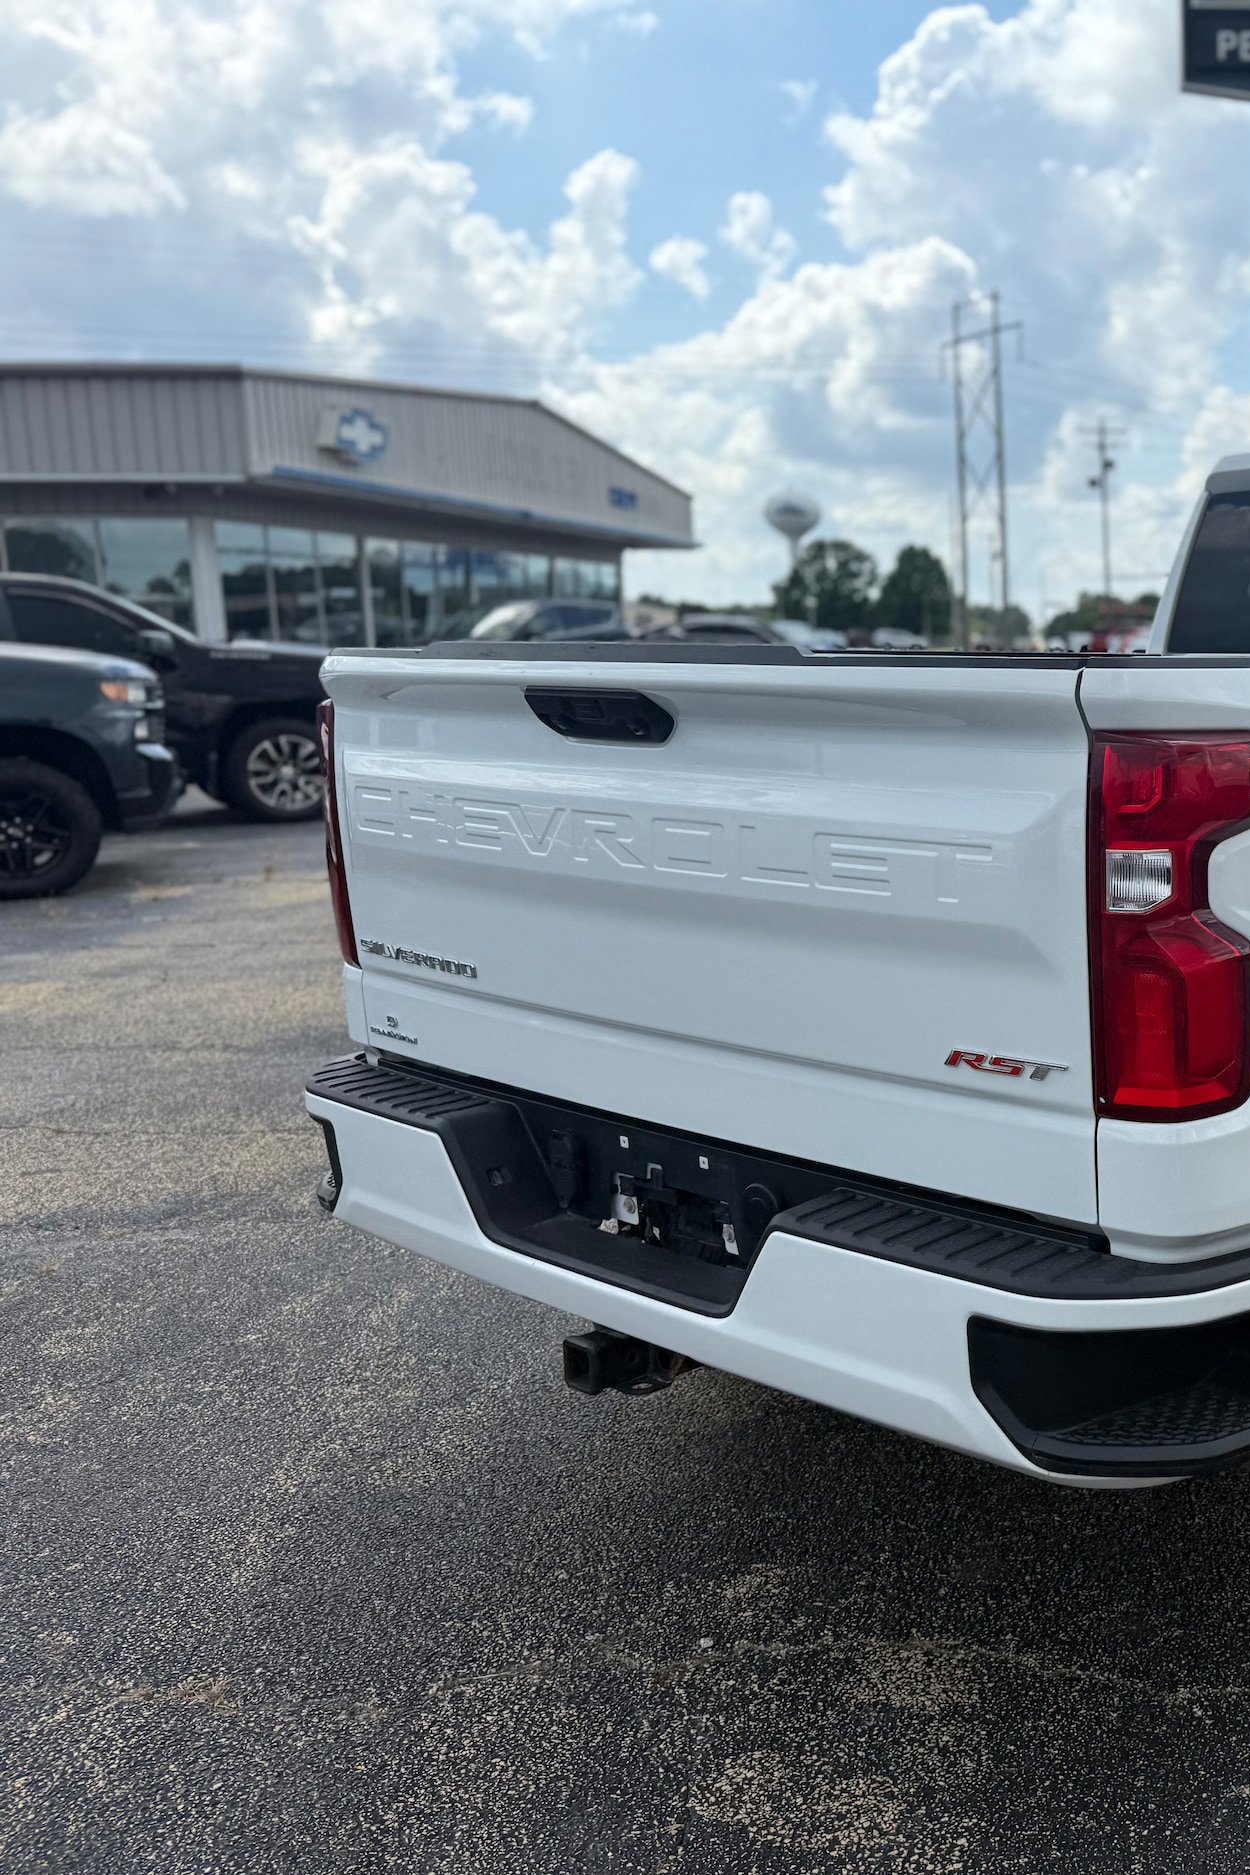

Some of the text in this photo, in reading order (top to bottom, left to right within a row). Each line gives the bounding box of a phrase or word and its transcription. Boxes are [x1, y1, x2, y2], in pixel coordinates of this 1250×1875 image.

[352, 783, 998, 905] CHEVROLET
[360, 938, 478, 979] SILVERADO
[944, 1047, 1070, 1082] RST
